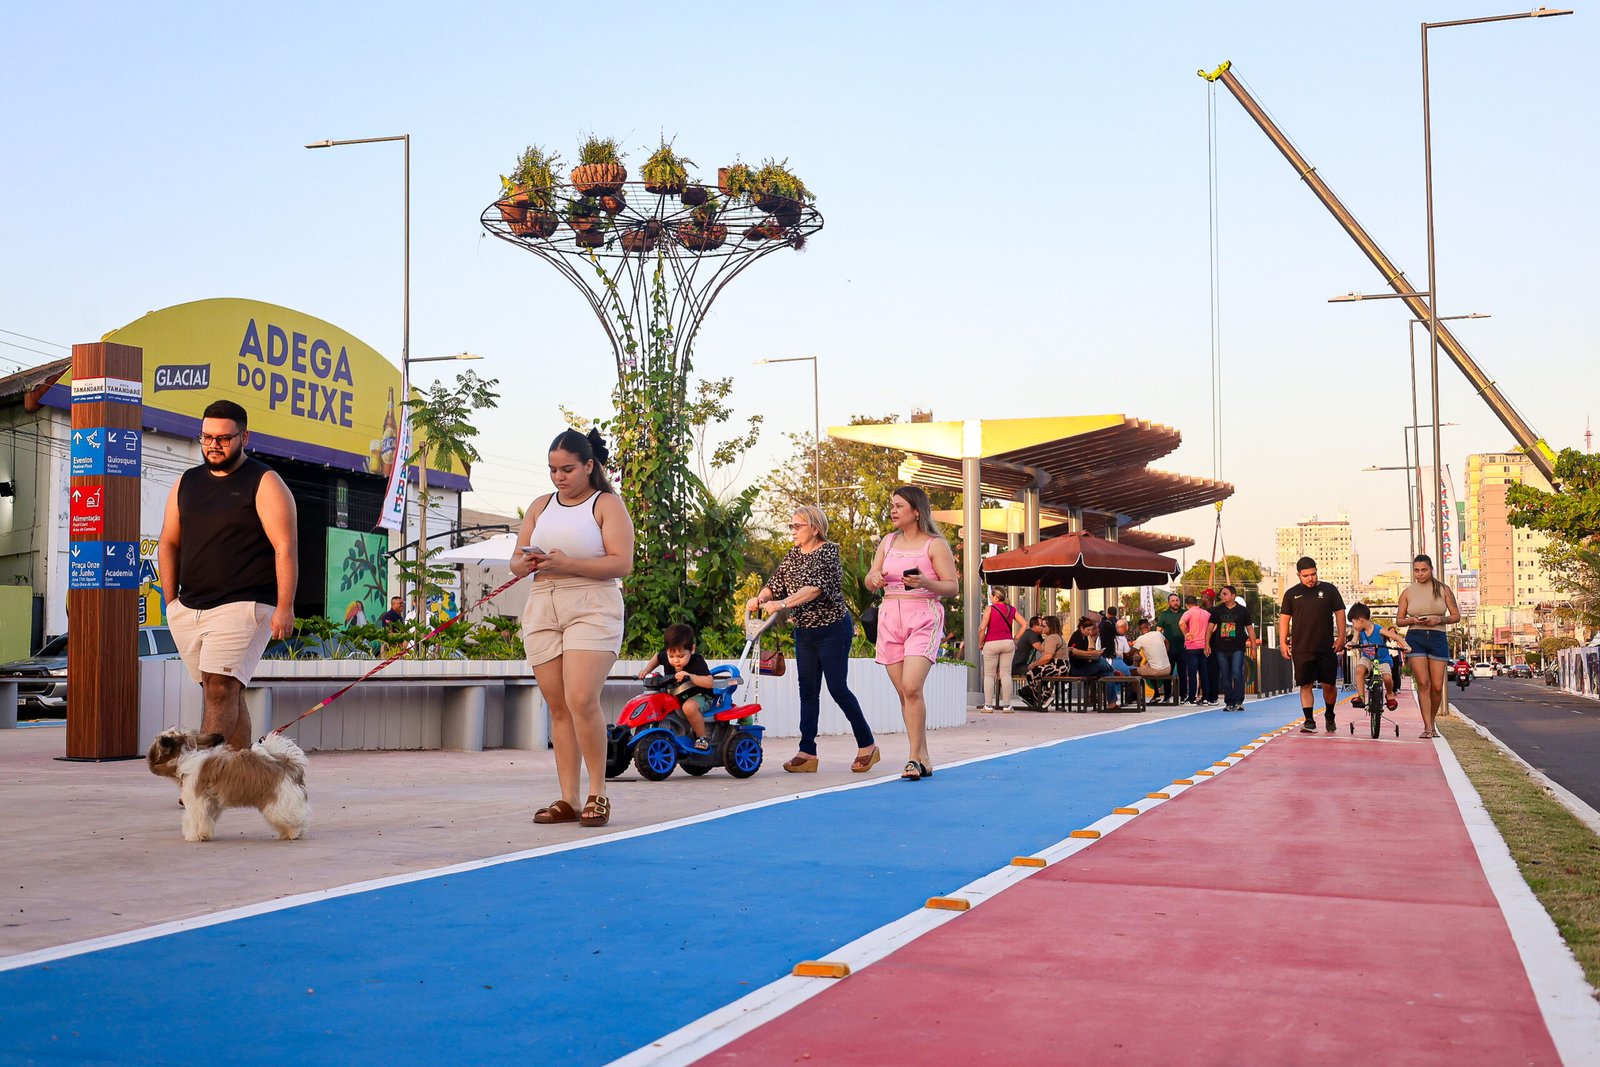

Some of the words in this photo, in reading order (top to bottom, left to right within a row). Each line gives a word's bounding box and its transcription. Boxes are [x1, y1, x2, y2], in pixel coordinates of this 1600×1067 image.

[239, 318, 354, 387] ADEGA
[156, 369, 209, 387] GLACIAL
[73, 385, 104, 393] TAMANDARÉ
[107, 385, 141, 395] TAMANDARÉ
[237, 362, 267, 392] DO
[269, 371, 354, 429] PEIXE
[73, 456, 93, 464] Eventos
[107, 455, 137, 466] Quiosques
[72, 514, 101, 523] Alimentação
[71, 561, 87, 569] Praça
[87, 561, 100, 569] Onze
[71, 569, 78, 577] de
[79, 569, 95, 577] Junho
[105, 569, 134, 577] Academia
